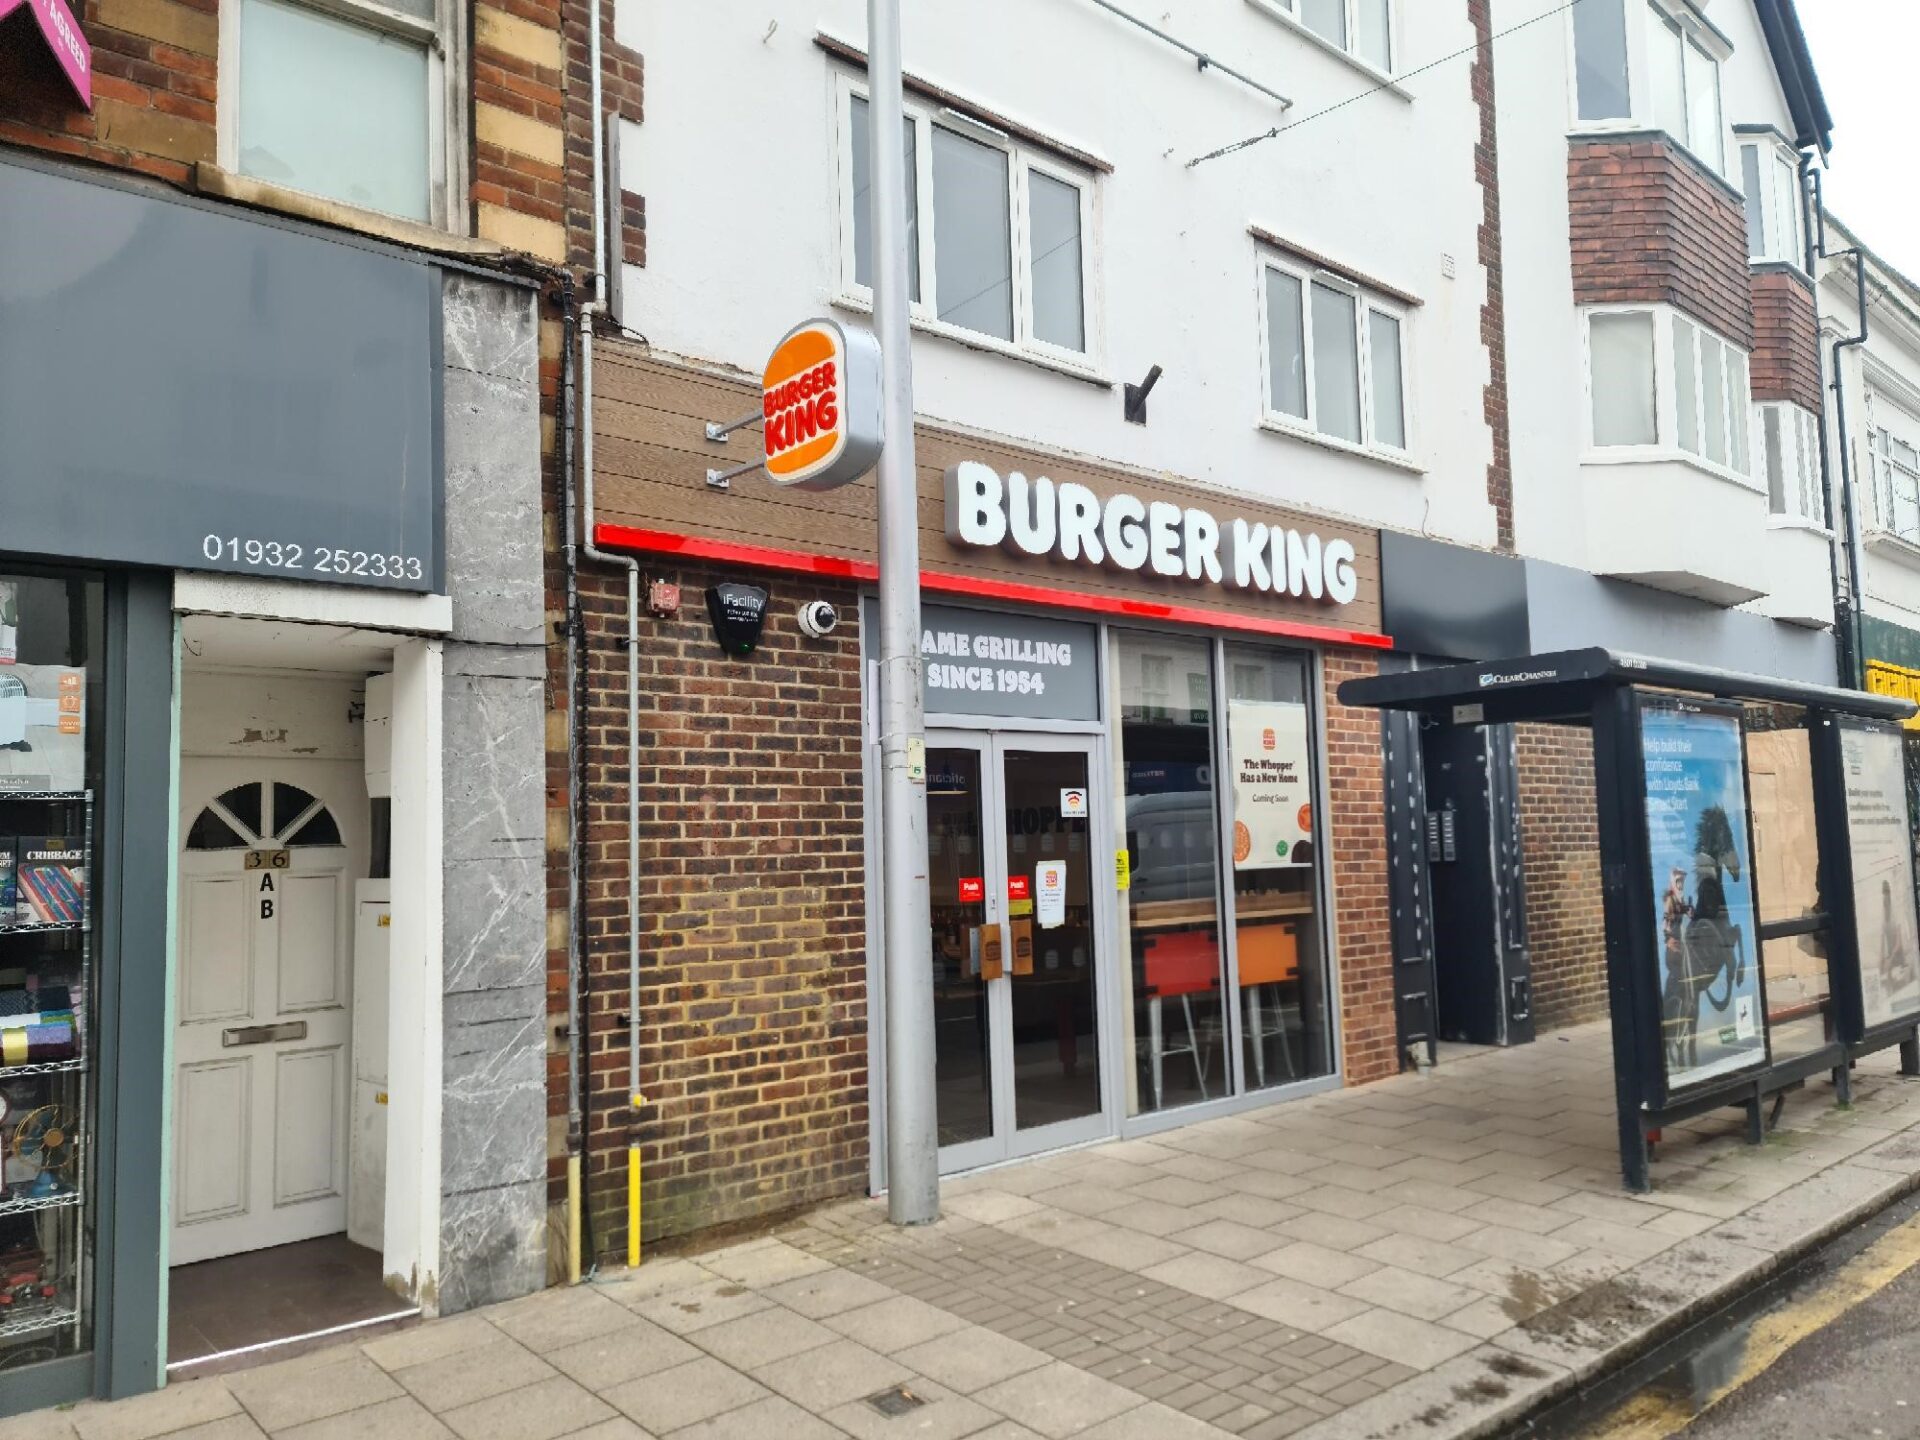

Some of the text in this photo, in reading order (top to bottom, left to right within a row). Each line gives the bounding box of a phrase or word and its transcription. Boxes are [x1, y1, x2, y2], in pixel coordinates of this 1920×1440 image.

[49, 0, 86, 73] AGREED
[764, 361, 836, 418] BURGER
[765, 391, 838, 456] KING
[957, 460, 1357, 604] BURGER KING
[203, 534, 423, 580] 01932 252333
[920, 630, 1072, 666] AME GRILLING
[927, 663, 1045, 695] SINCE 1954
[1240, 772, 1255, 783] Has
[1256, 775, 1262, 783] a
[1262, 773, 1277, 783] New
[1243, 759, 1293, 773] The Whopper
[27, 849, 83, 860] CRIBBAGE
[260, 872, 275, 892] A
[261, 899, 274, 919] B
